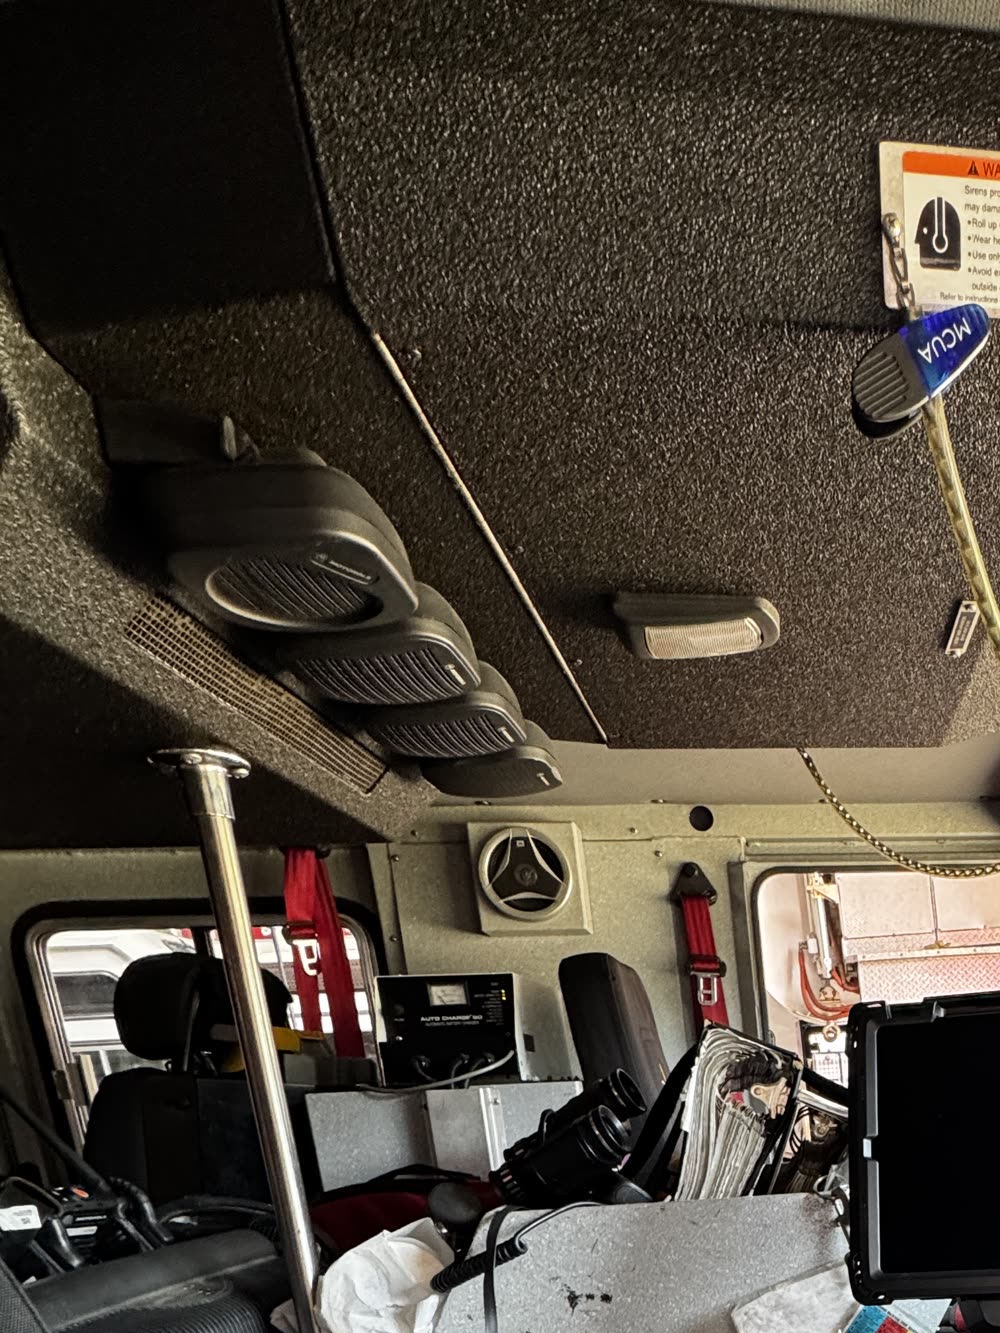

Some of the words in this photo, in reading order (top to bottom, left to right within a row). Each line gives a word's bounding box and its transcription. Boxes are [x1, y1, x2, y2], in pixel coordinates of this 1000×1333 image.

[964, 185, 988, 197] Sirens
[964, 203, 980, 214] may
[972, 218, 986, 228] Roll
[988, 220, 997, 231] up
[972, 251, 986, 260] Use
[972, 266, 993, 277] Avoid
[971, 281, 998, 292] outside
[964, 294, 998, 304] instructions
[917, 317, 972, 364] MCUA
